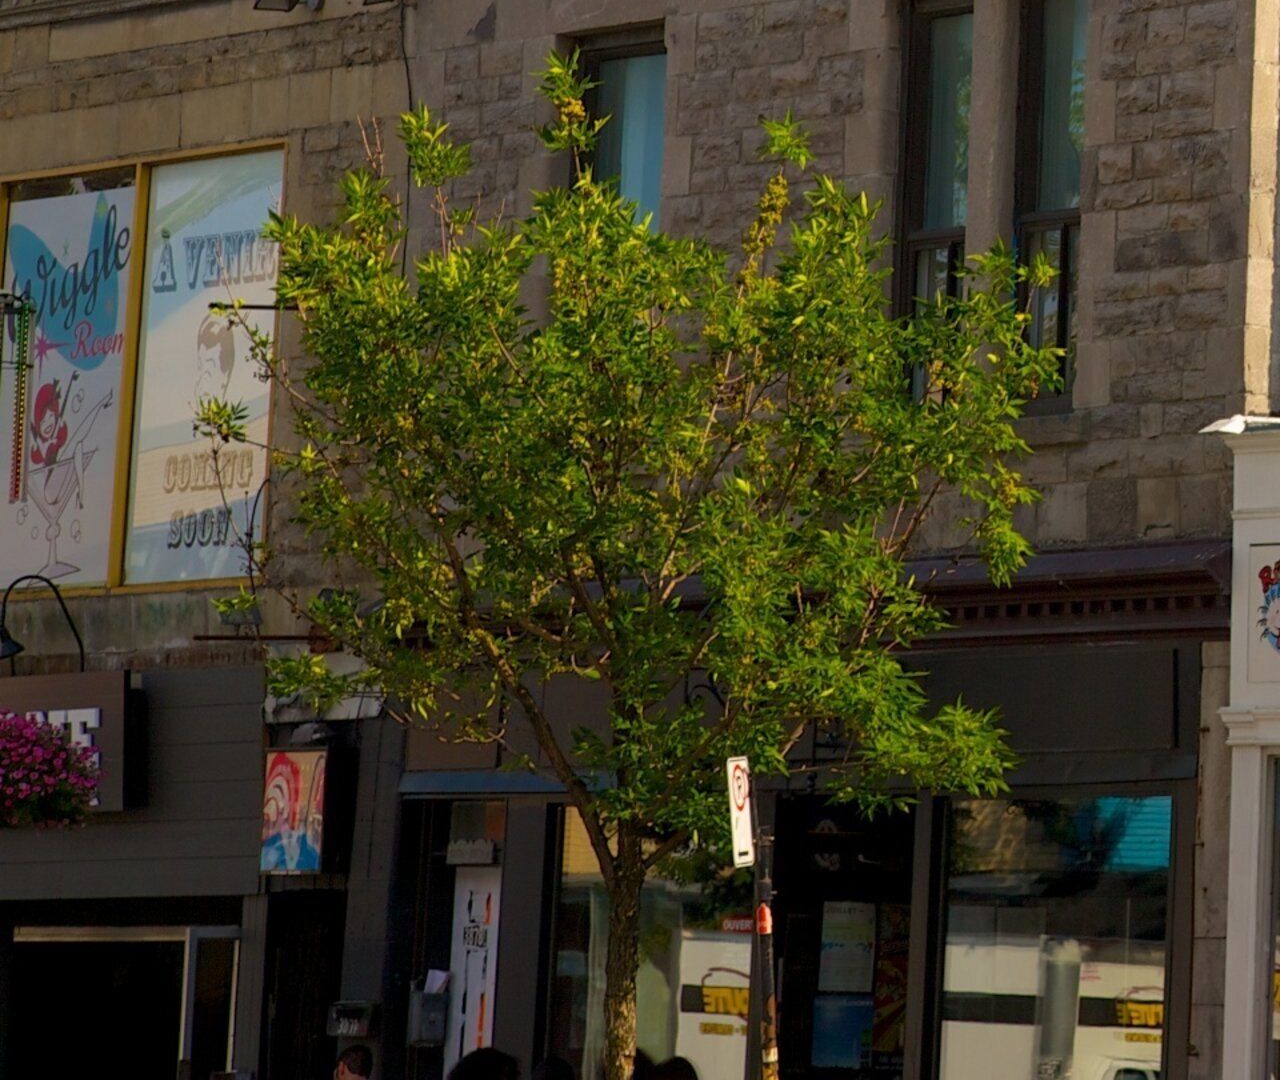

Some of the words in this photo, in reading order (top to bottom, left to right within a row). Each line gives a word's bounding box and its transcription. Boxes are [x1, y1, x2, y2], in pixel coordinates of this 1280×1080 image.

[163, 449, 253, 493] COMING
[167, 510, 231, 549] SOON
[722, 918, 753, 932] OUVER
